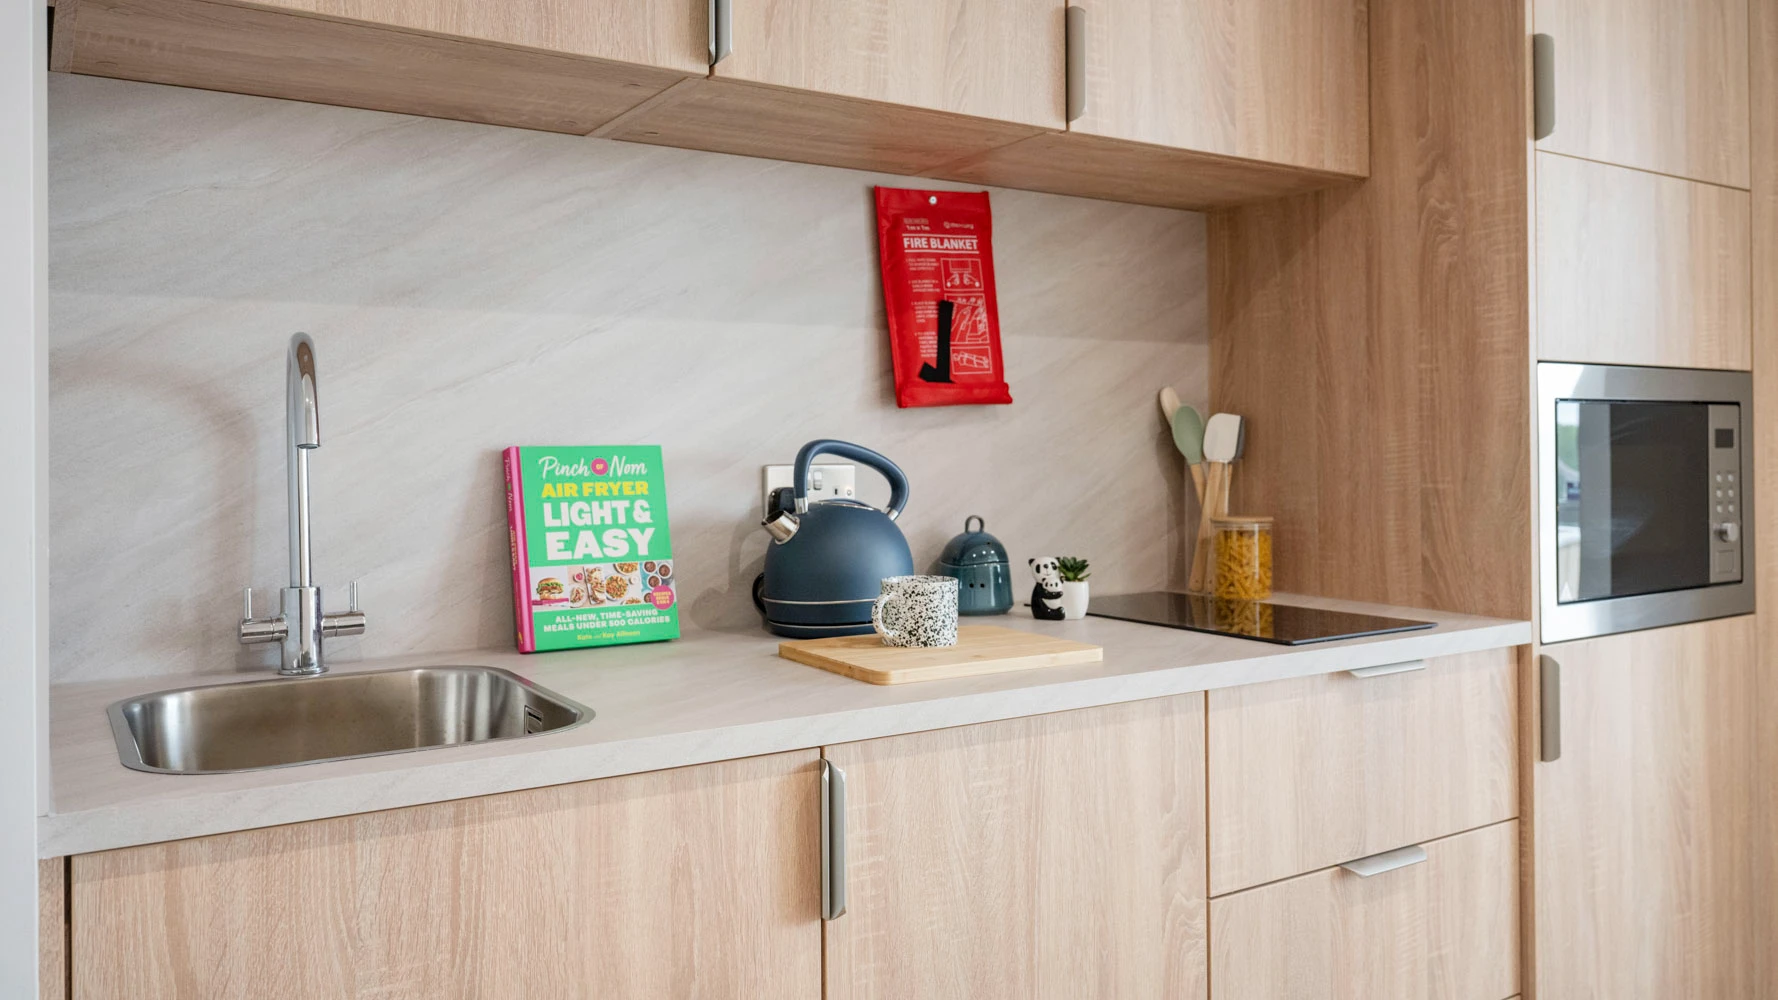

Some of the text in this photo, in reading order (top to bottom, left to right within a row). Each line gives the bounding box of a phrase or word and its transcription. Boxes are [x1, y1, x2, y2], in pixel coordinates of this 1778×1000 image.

[903, 237, 978, 250] FIRE BLANKET
[538, 455, 590, 480] Pinch
[609, 455, 647, 477] Nom
[541, 481, 649, 498] AIR FRYER
[543, 499, 653, 527] LIGHT &
[545, 528, 655, 561] EASY
[543, 616, 671, 632] MEALS UNDER 500 CALORIES
[555, 609, 658, 623] ALL-NEW, TIME-SAVING
